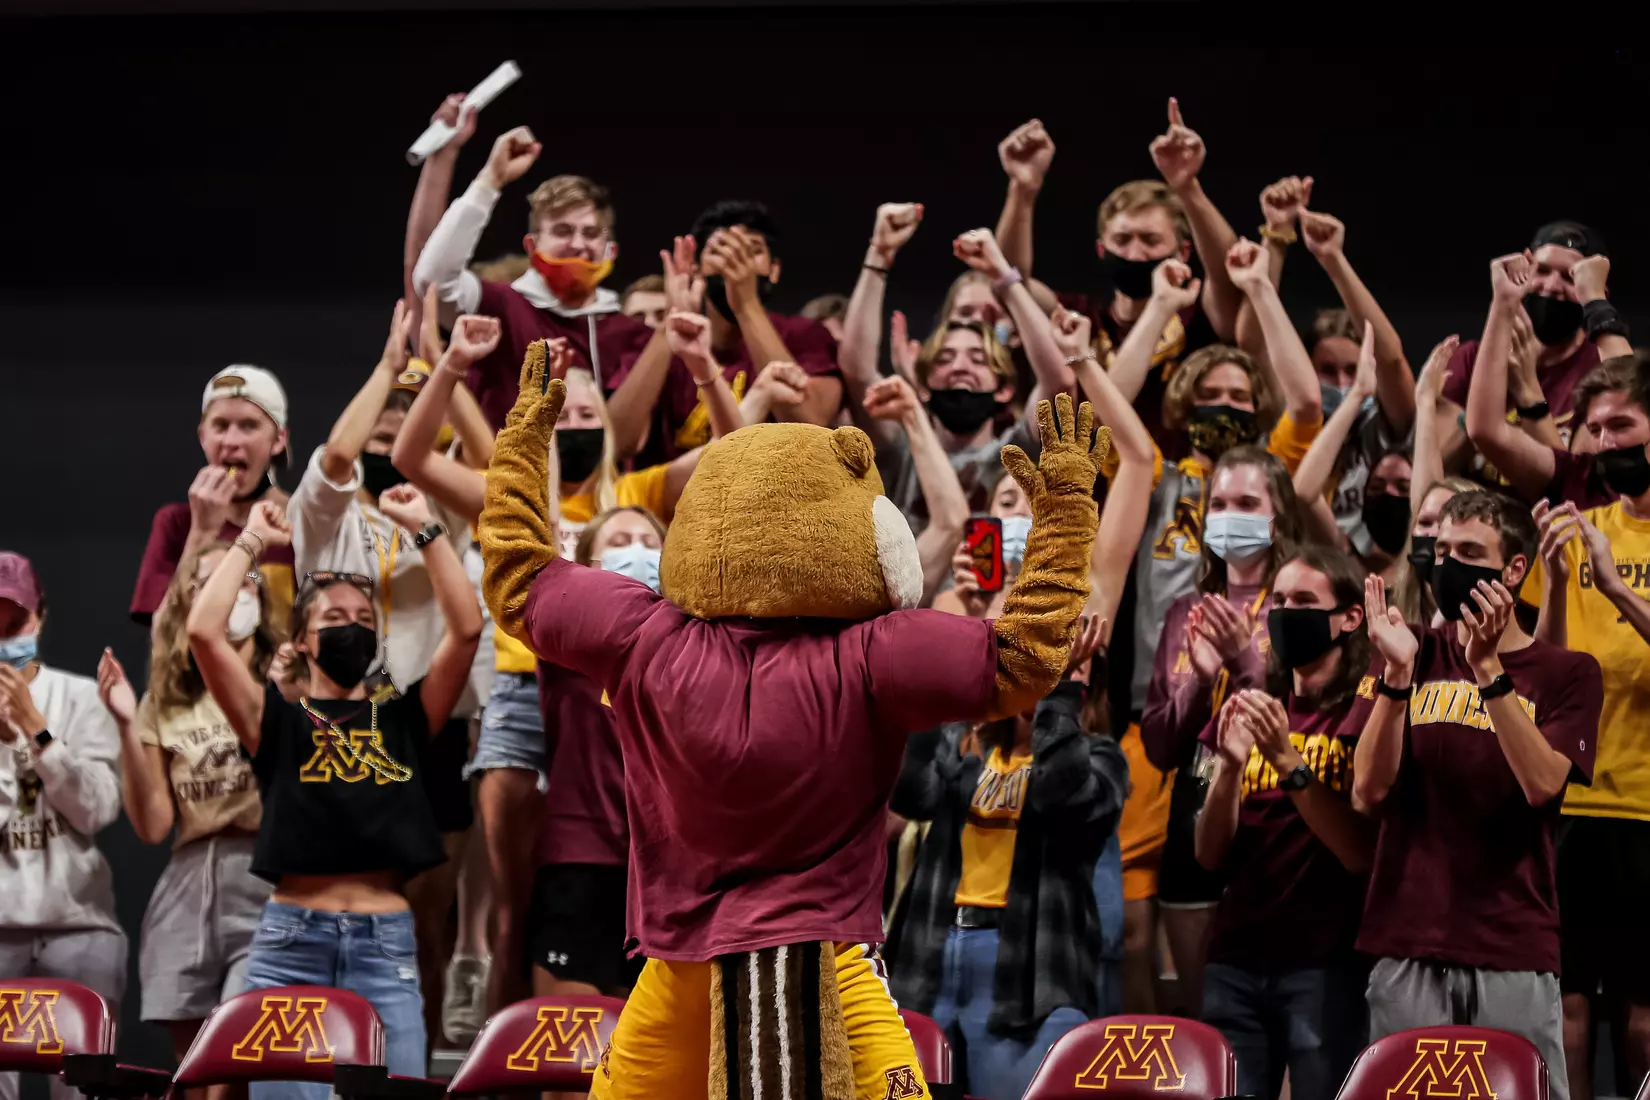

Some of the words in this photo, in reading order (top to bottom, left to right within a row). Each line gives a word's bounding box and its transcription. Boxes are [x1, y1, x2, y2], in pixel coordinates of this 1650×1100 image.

[232, 996, 335, 1063] M
[506, 1005, 605, 1073] M
[1075, 1024, 1187, 1091] M
[882, 1064, 924, 1100] M
[1386, 1038, 1499, 1100] M
